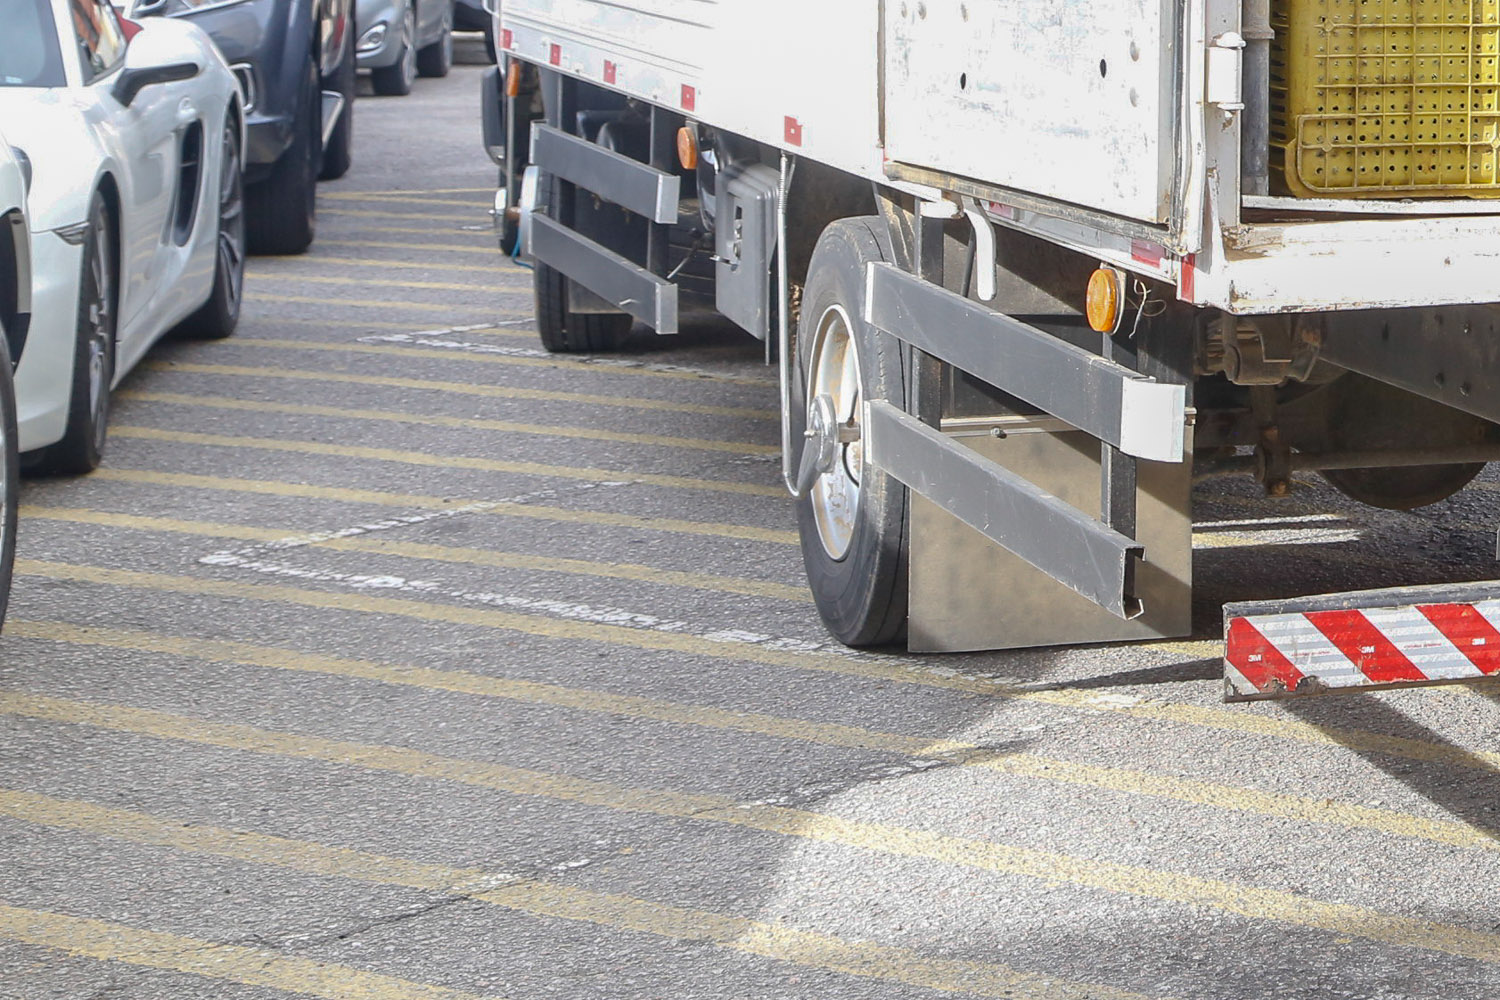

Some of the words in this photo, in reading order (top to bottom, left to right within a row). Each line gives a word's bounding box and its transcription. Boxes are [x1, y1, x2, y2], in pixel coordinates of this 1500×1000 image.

[1471, 637, 1485, 645] 3M
[1361, 645, 1374, 653] 3M
[1248, 654, 1262, 662] 3M
